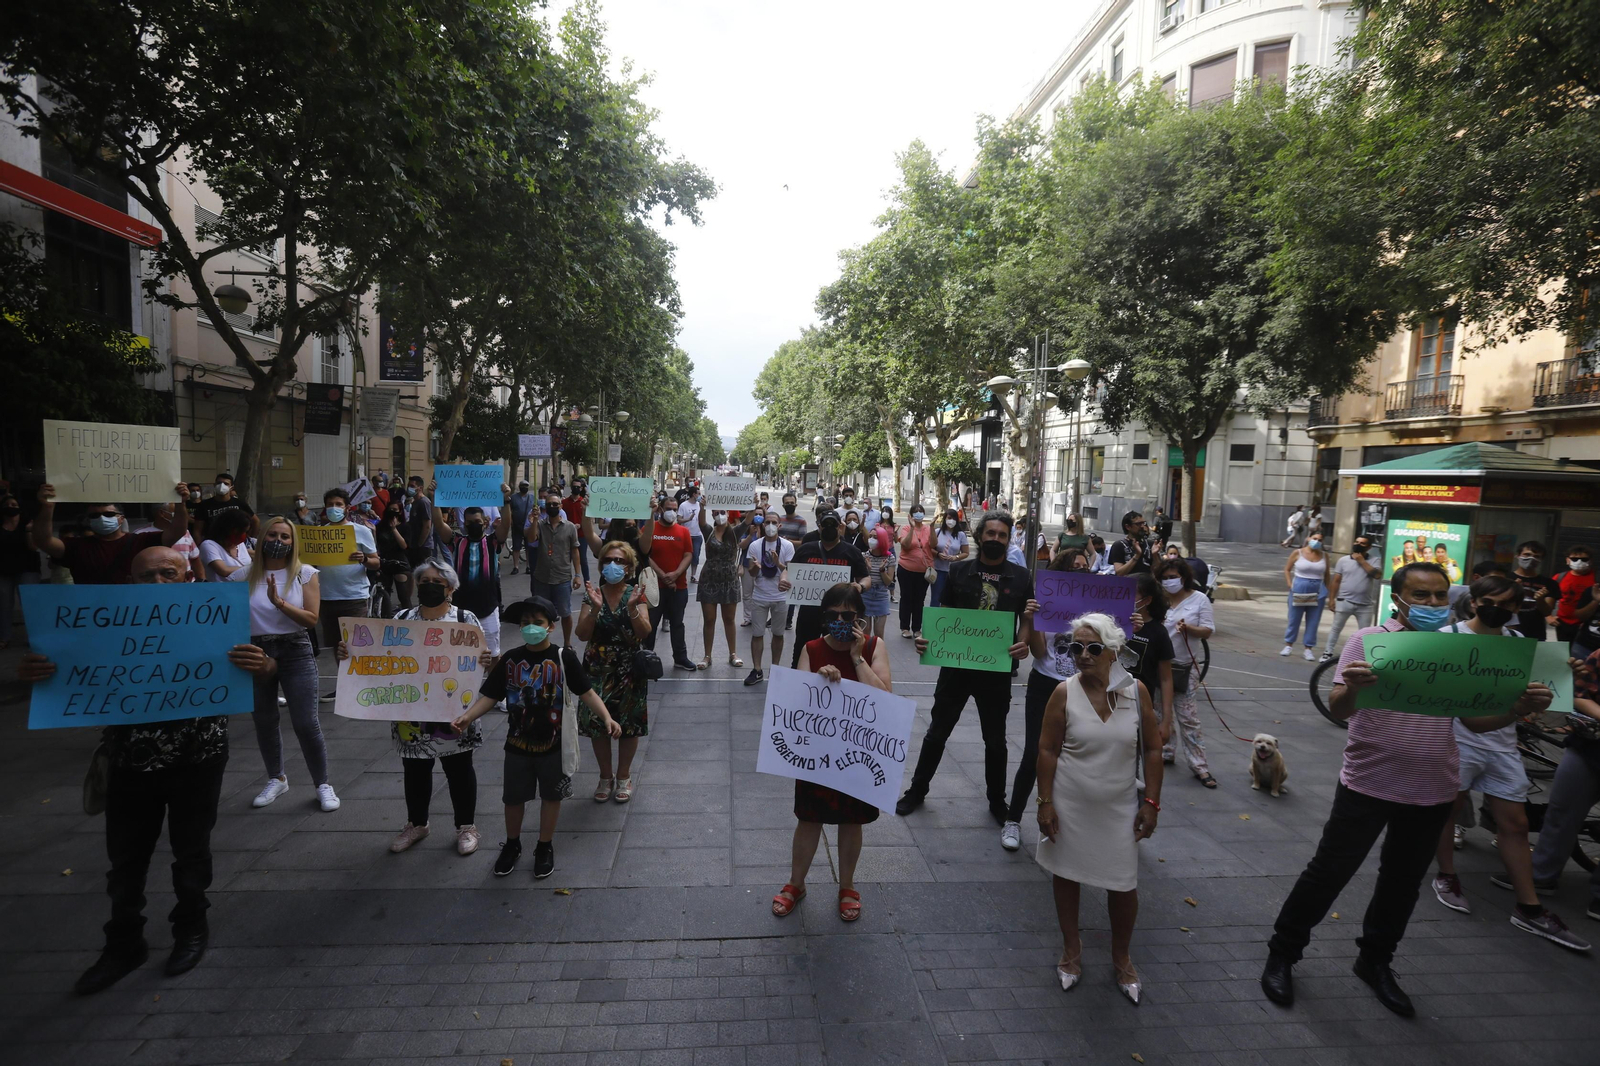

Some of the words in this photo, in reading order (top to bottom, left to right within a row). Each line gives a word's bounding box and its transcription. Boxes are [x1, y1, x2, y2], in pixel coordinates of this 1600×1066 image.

[57, 428, 131, 449] FACTURA
[137, 433, 149, 450] DE
[154, 434, 179, 451] LUZ
[78, 451, 155, 470] EMBROLLO
[75, 473, 89, 492] Y
[440, 470, 454, 478] NO
[463, 470, 502, 478] RECORTES
[466, 480, 477, 488] DE
[708, 480, 722, 491] MÁS
[707, 494, 753, 505] RENOVABLES
[1394, 529, 1431, 538] JUGAMOS
[1432, 531, 1461, 542] TODOS
[305, 542, 344, 554] USURERAS
[796, 568, 848, 582] ELÉCTRICAS
[790, 586, 826, 600] ABUSO
[1040, 578, 1080, 597] STOP
[1082, 583, 1130, 600] POBREZA
[55, 597, 231, 628] REGULACIÓN
[382, 625, 414, 646] LUZ
[424, 628, 444, 646] ES
[451, 628, 479, 648] UNA
[936, 616, 1004, 643] Gobiernos
[121, 635, 170, 656] DEL
[930, 640, 996, 666] Cómplices
[347, 650, 419, 675] NECESIDAD
[427, 656, 451, 674] NO
[457, 656, 477, 672] UN
[1370, 646, 1464, 684] Energías
[1467, 647, 1526, 686] limpias
[67, 661, 213, 687] MERCADO
[63, 686, 229, 716] ELÉCTRICO
[1379, 681, 1401, 701] Y
[1406, 693, 1504, 714] asequibles
[773, 704, 836, 737] Puertas
[840, 719, 906, 763] giratorias
[794, 736, 810, 745] DE
